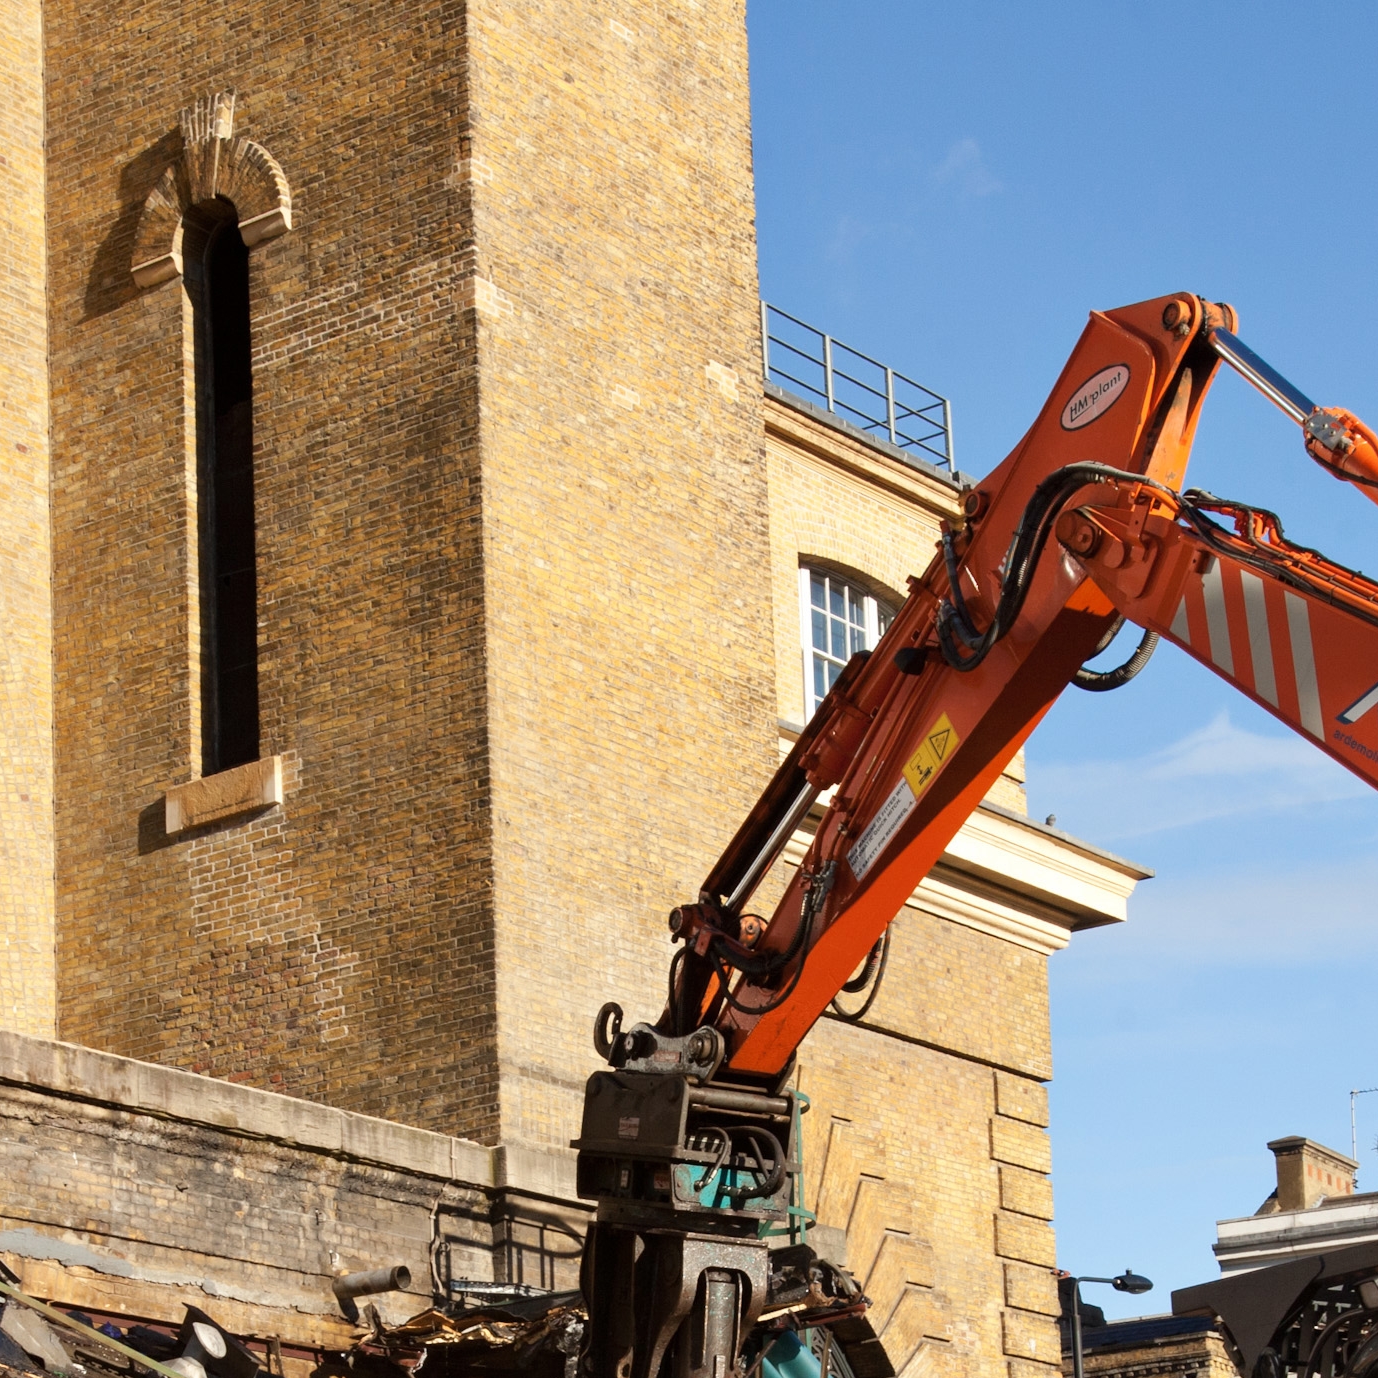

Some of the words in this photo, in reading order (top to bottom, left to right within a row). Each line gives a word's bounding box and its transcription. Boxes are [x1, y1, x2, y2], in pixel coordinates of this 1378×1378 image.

[1069, 396, 1088, 416] HM
[1090, 371, 1122, 405] plant
[850, 834, 874, 867] AUTOMATIC
[873, 817, 887, 836] QUICK
[858, 823, 876, 848] MACHINE
[882, 796, 896, 817] FITTED
[855, 868, 862, 877] NO
[862, 847, 879, 868] SAFETY
[878, 836, 886, 847] PIN
